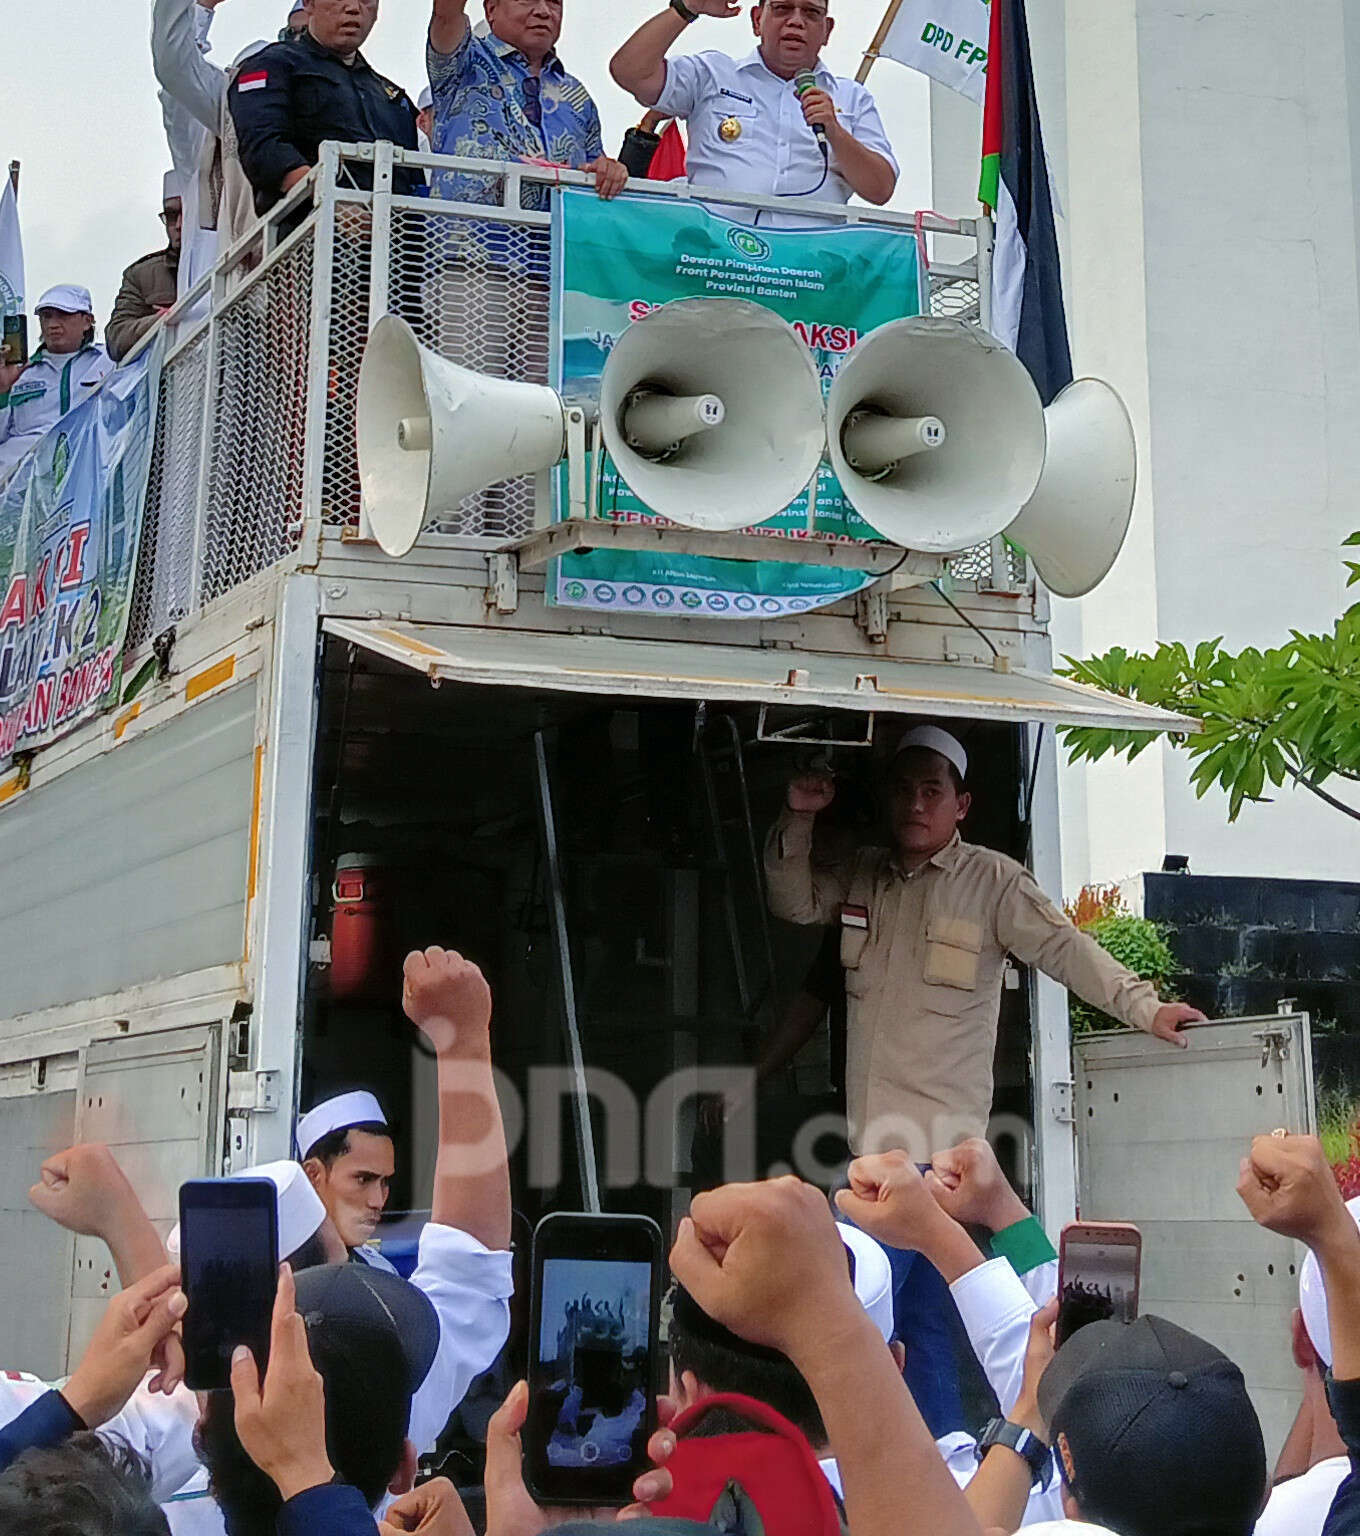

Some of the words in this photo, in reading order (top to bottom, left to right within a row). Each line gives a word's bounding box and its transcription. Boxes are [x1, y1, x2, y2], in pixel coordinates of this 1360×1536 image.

[921, 22, 954, 53] DPD
[675, 265, 709, 278] Front
[709, 268, 794, 287] Persaudaraan
[794, 278, 825, 291] Islam
[680, 253, 724, 267] Dewan
[725, 258, 780, 275] Pimpinan
[780, 266, 822, 279] Daerah
[706, 280, 755, 295] Provinsi
[756, 286, 798, 299] Banten
[80, 585, 102, 652] 2
